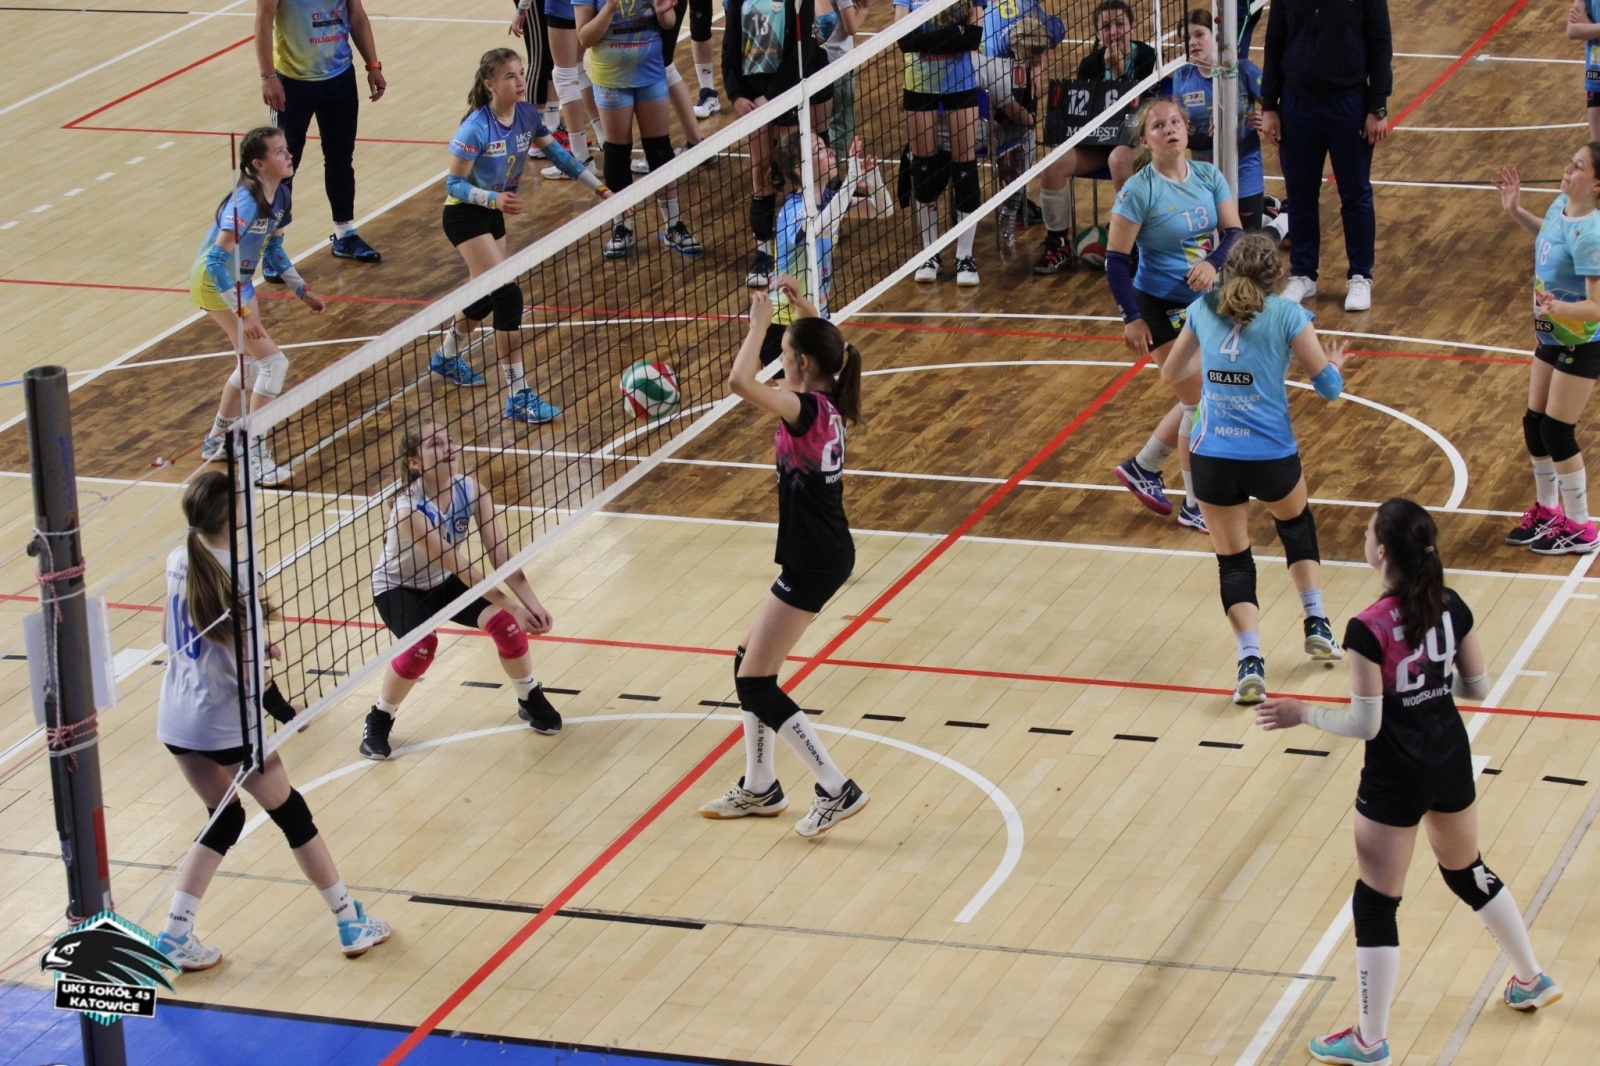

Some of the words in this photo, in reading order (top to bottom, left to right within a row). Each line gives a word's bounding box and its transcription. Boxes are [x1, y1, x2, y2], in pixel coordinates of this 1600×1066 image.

[752, 13, 769, 35] 13
[1586, 71, 1600, 79] BR
[1068, 89, 1090, 116] 12
[516, 131, 532, 144] MKS
[1066, 126, 1118, 138] MDEST
[506, 155, 516, 177] 2
[1181, 206, 1210, 232] 13
[1536, 237, 1551, 266] 18
[1219, 323, 1242, 363] 4
[1208, 371, 1251, 384] BRAKS
